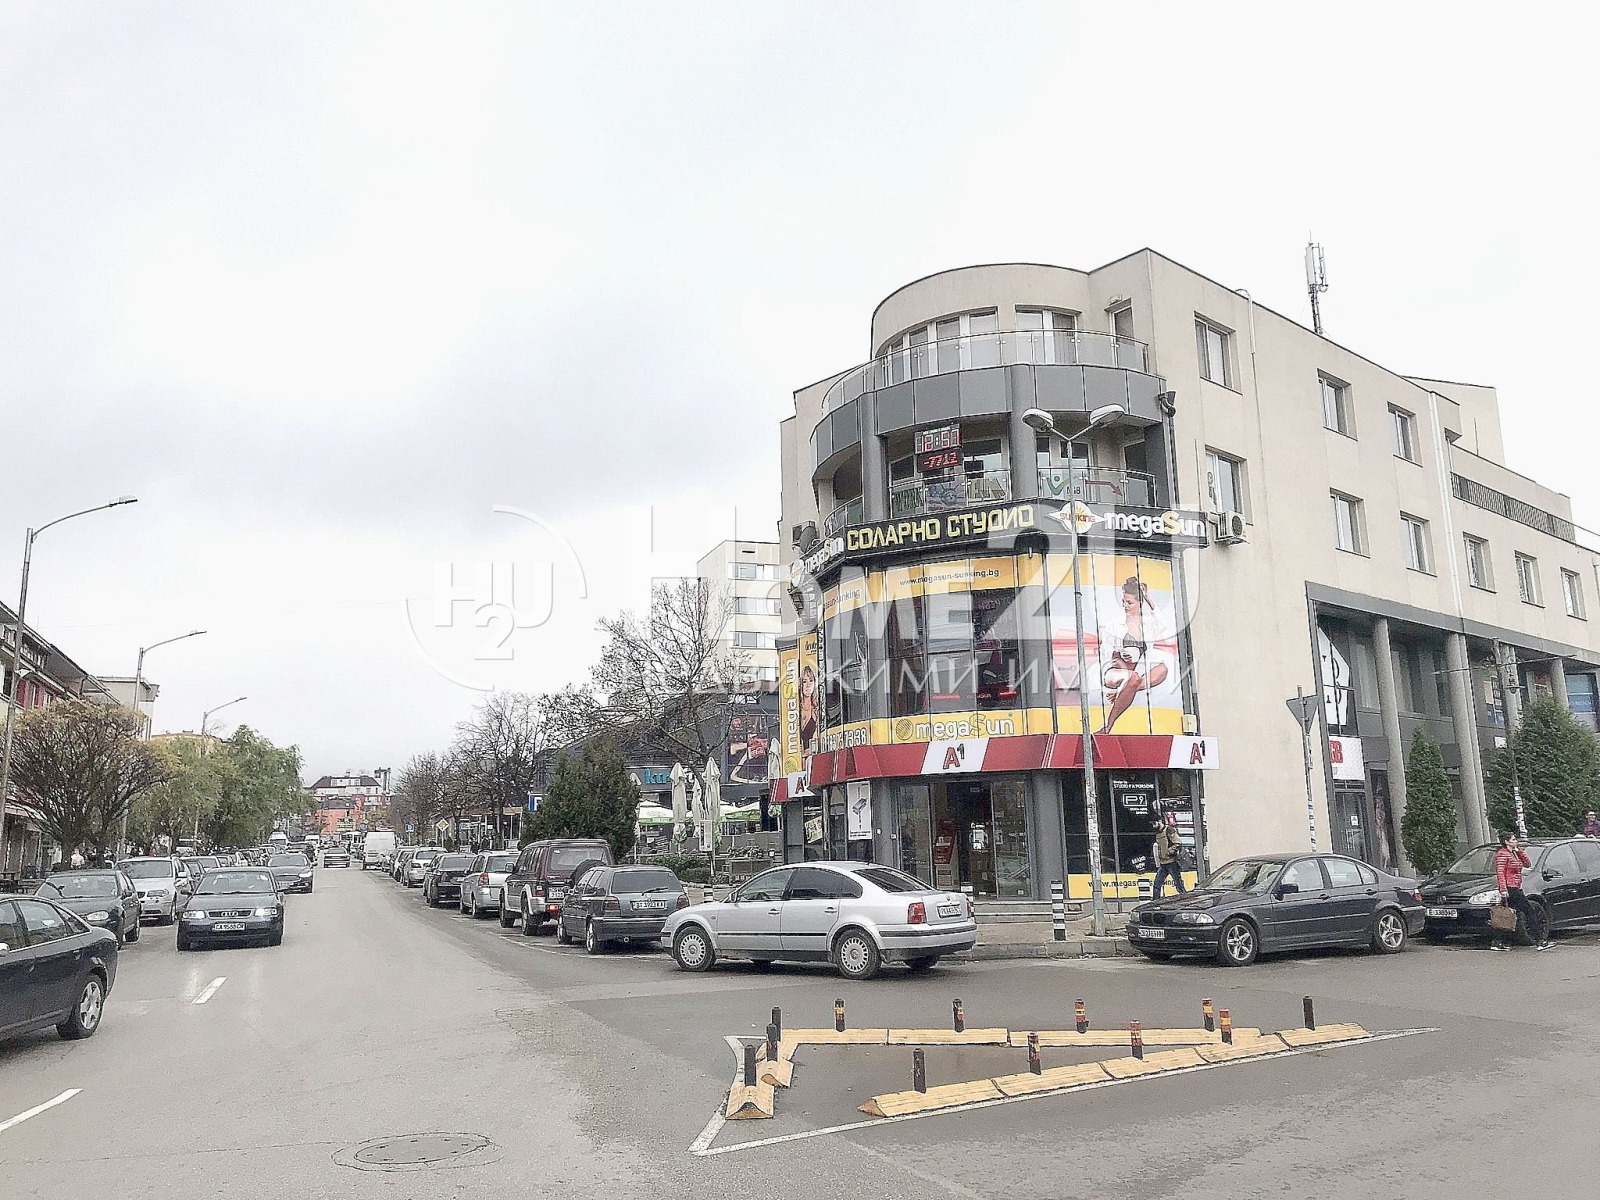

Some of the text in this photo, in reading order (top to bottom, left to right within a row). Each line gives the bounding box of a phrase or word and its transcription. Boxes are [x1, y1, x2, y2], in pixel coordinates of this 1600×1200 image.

[847, 504, 1034, 551] СОЛАРНО СТУДИО
[1104, 511, 1205, 538] megaSun
[783, 659, 799, 754] megaSun
[916, 713, 1014, 741] megaSun
[942, 743, 965, 770] A1
[1189, 740, 1206, 765] A1
